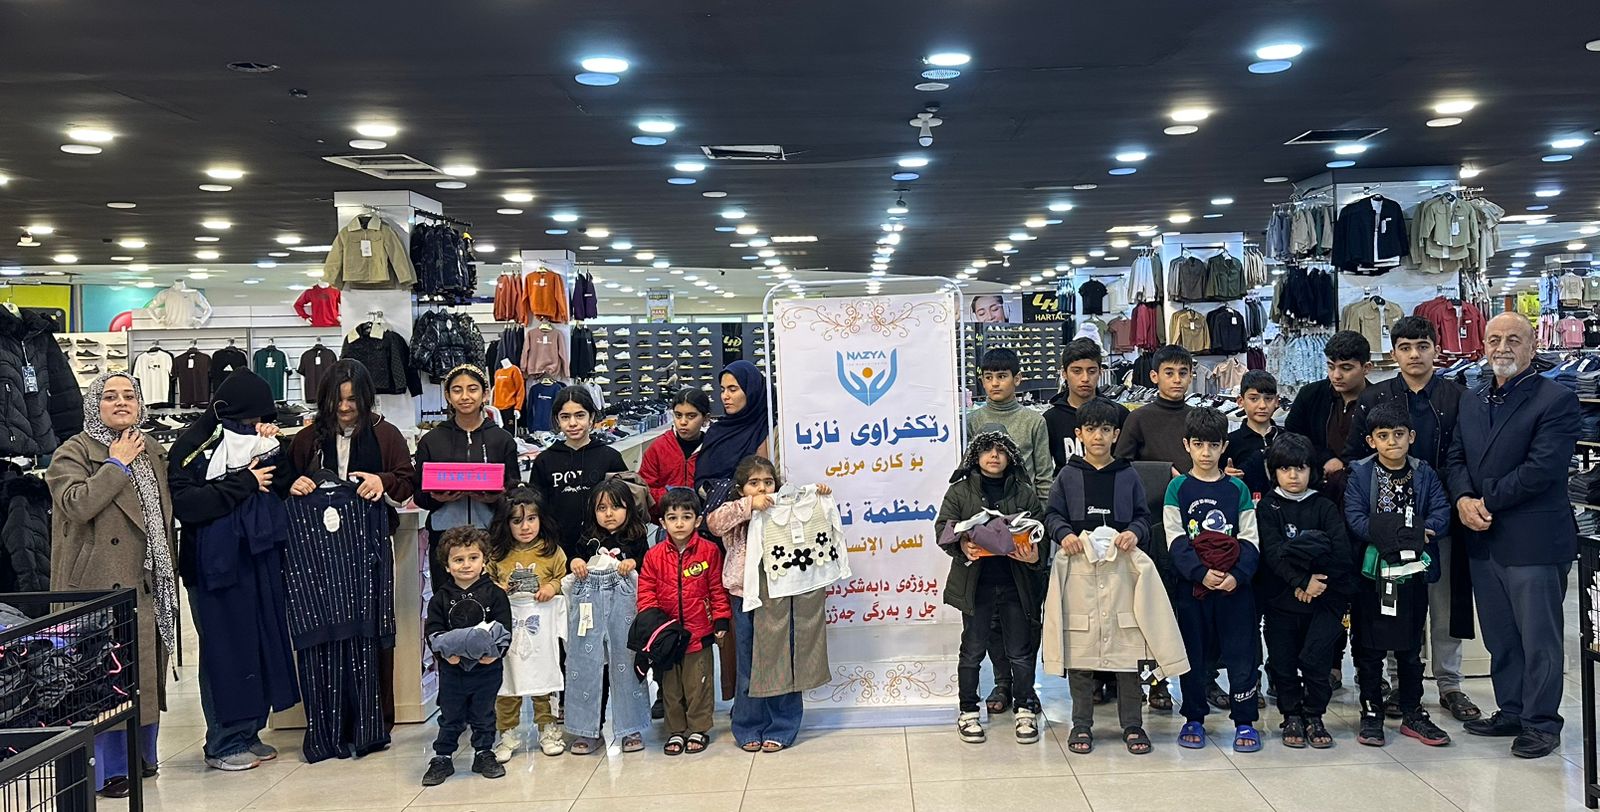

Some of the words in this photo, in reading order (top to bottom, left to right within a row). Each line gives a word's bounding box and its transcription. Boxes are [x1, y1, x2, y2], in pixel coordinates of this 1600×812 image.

[1035, 312, 1066, 321] HARTAL
[846, 350, 887, 361] NAZYA
[910, 452, 924, 472] بۆ
[863, 499, 938, 524] منظمة
[890, 534, 924, 553] للعمل
[905, 606, 913, 619] و
[919, 601, 937, 618] جل
